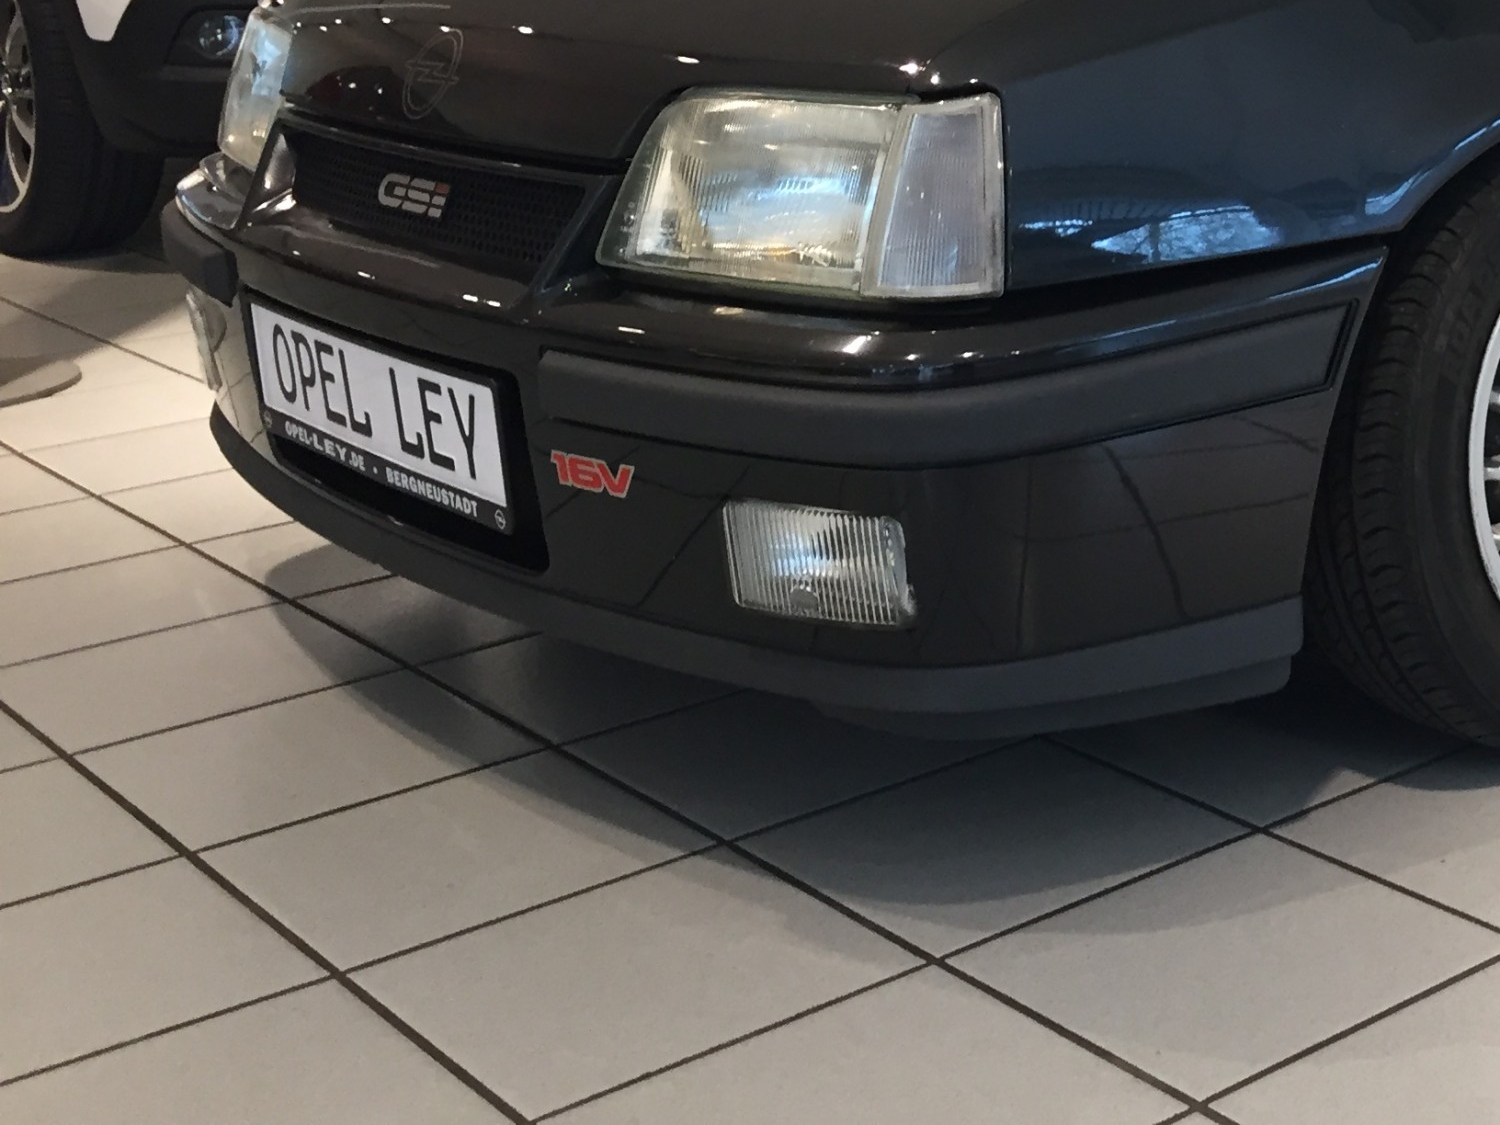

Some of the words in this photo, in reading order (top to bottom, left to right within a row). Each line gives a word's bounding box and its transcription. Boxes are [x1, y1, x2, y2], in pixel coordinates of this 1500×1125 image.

[272, 323, 373, 438] OPEL
[388, 366, 477, 481] LEY
[385, 466, 478, 518] BERGNEUSTADT
[550, 449, 635, 499] 16V
